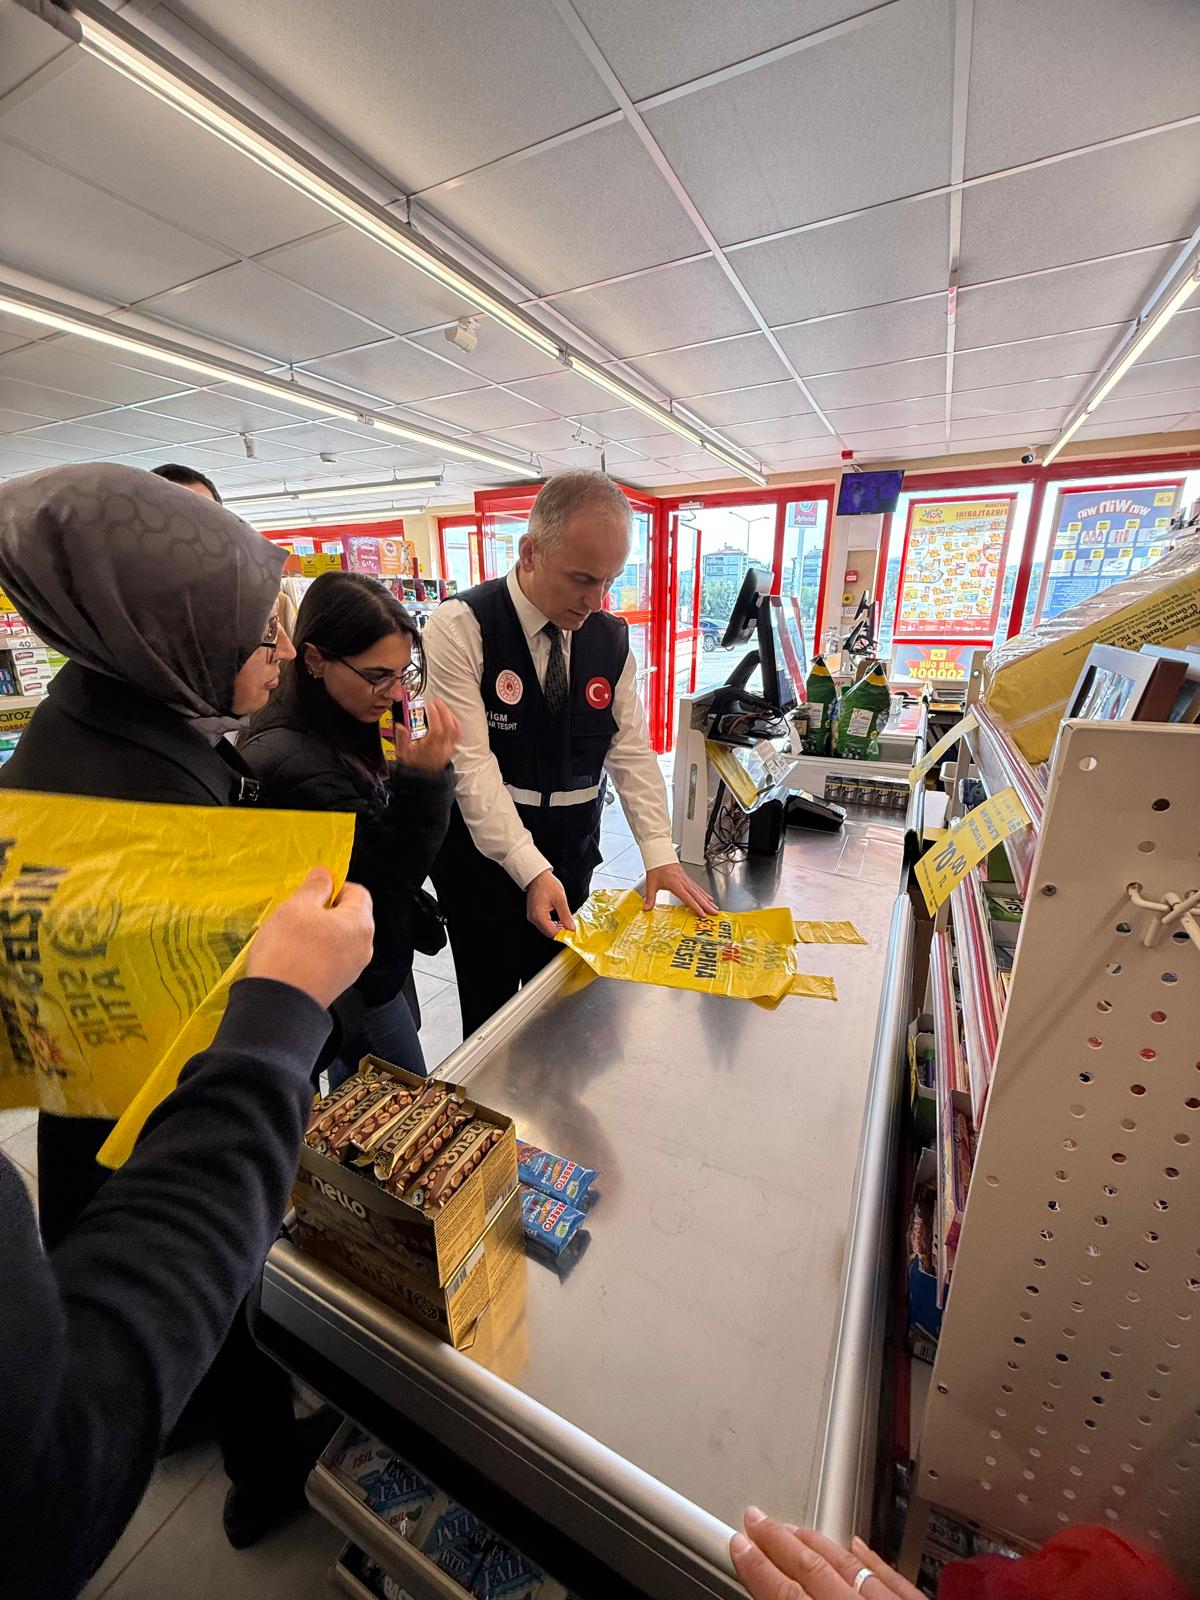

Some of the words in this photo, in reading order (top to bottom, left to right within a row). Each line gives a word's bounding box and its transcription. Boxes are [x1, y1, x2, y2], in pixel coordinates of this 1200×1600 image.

[1140, 624, 1169, 640] Plastik
[0, 723, 27, 732] TORBA
[497, 722, 518, 731] TESPİT
[670, 937, 699, 970] GELSİN
[555, 1161, 578, 1190] BEBETO
